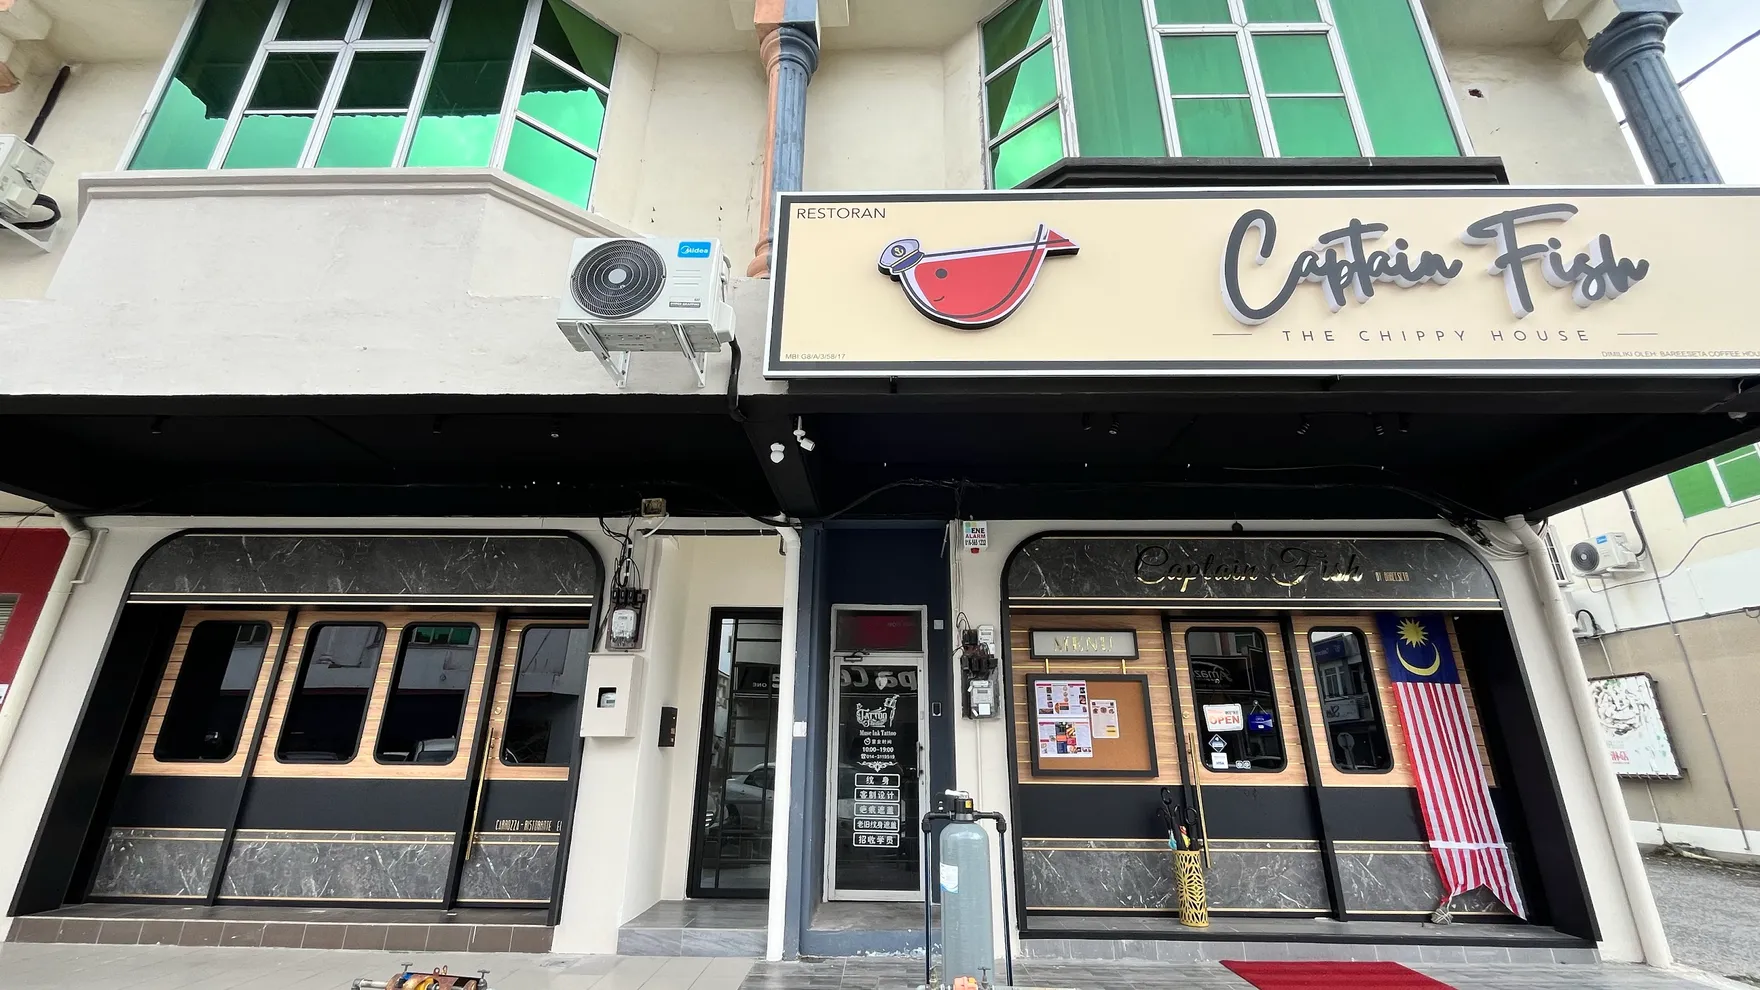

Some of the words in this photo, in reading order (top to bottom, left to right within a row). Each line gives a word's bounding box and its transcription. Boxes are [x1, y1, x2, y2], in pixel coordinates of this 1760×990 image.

[797, 207, 886, 219] RESTORAN
[681, 245, 709, 254] Midea
[1222, 208, 1463, 323] Captain
[1461, 202, 1650, 317] Fish
[1283, 330, 1334, 342] THE
[1359, 330, 1465, 342] CHIPPY
[1491, 330, 1588, 342] HOUSE
[1708, 350, 1741, 358] COFFEE
[1134, 545, 1259, 592] Captain
[1266, 547, 1364, 587] Fish
[1053, 636, 1114, 652] MENU
[1209, 715, 1240, 725] OPEN
